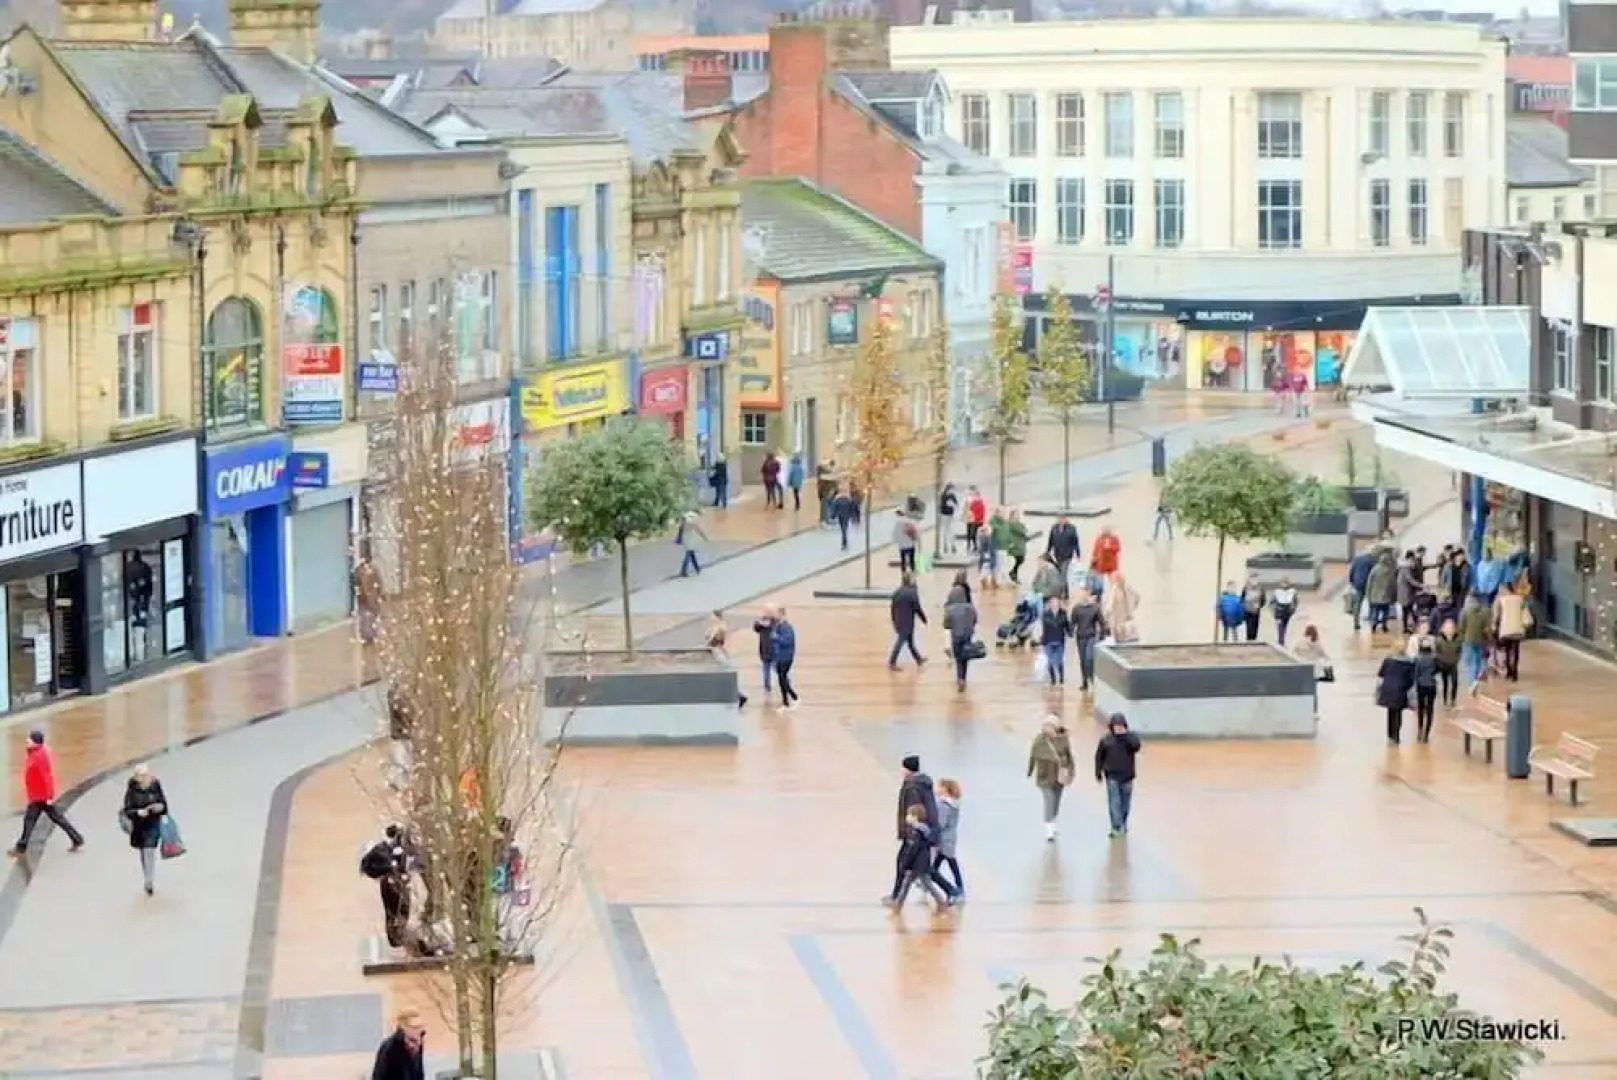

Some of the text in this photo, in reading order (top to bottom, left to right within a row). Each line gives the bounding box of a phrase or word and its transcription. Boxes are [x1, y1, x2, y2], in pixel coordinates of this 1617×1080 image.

[1195, 311, 1255, 322] BURTON
[217, 458, 278, 499] CORAL
[0, 498, 74, 547] rniture
